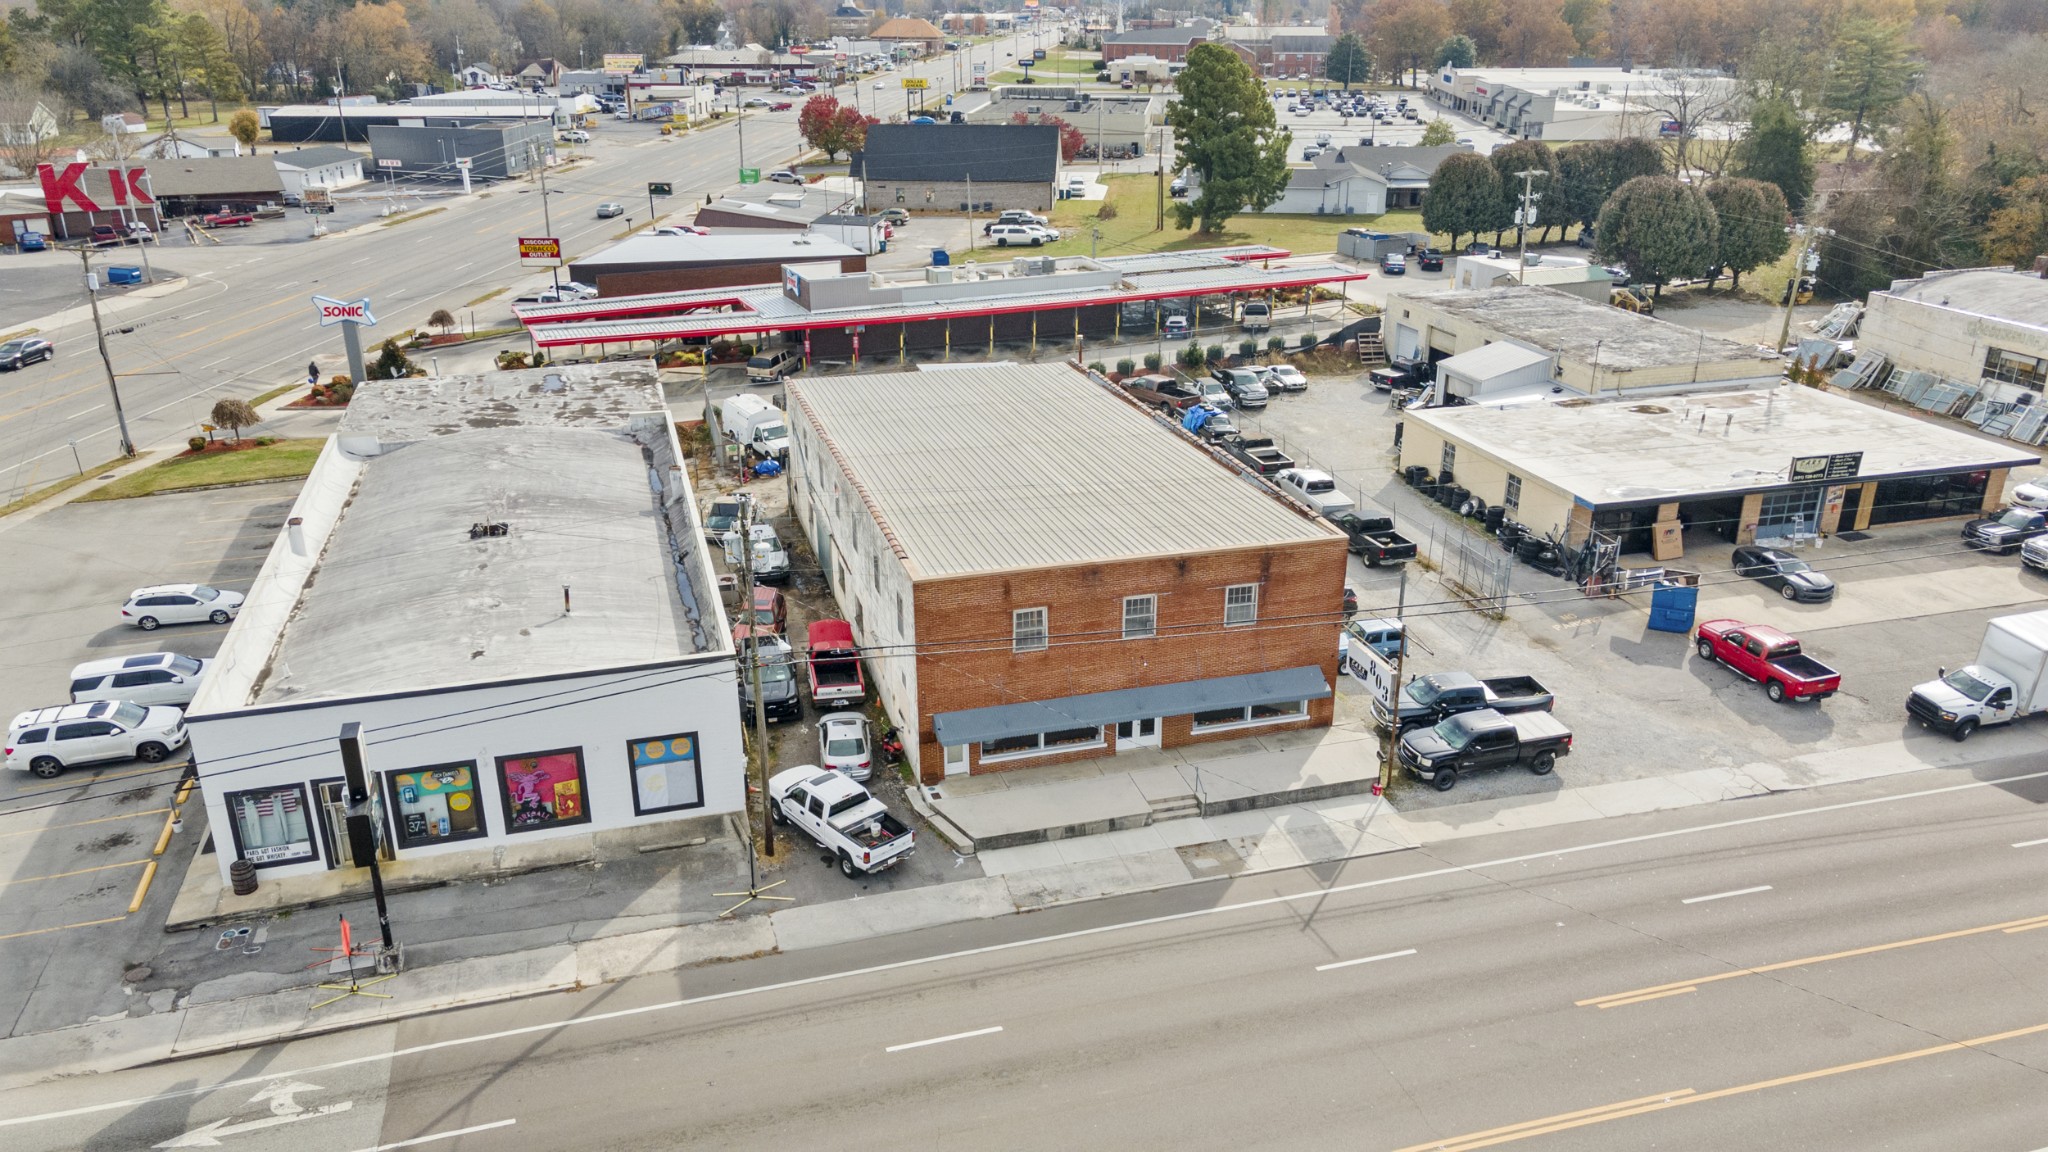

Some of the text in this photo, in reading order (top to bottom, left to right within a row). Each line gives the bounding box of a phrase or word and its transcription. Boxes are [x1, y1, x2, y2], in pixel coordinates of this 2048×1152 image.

[37, 162, 102, 214] K
[323, 306, 363, 317] SONIC
[1369, 659, 1389, 702] 803
[408, 820, 421, 833] 37
[246, 849, 260, 857] PARIS
